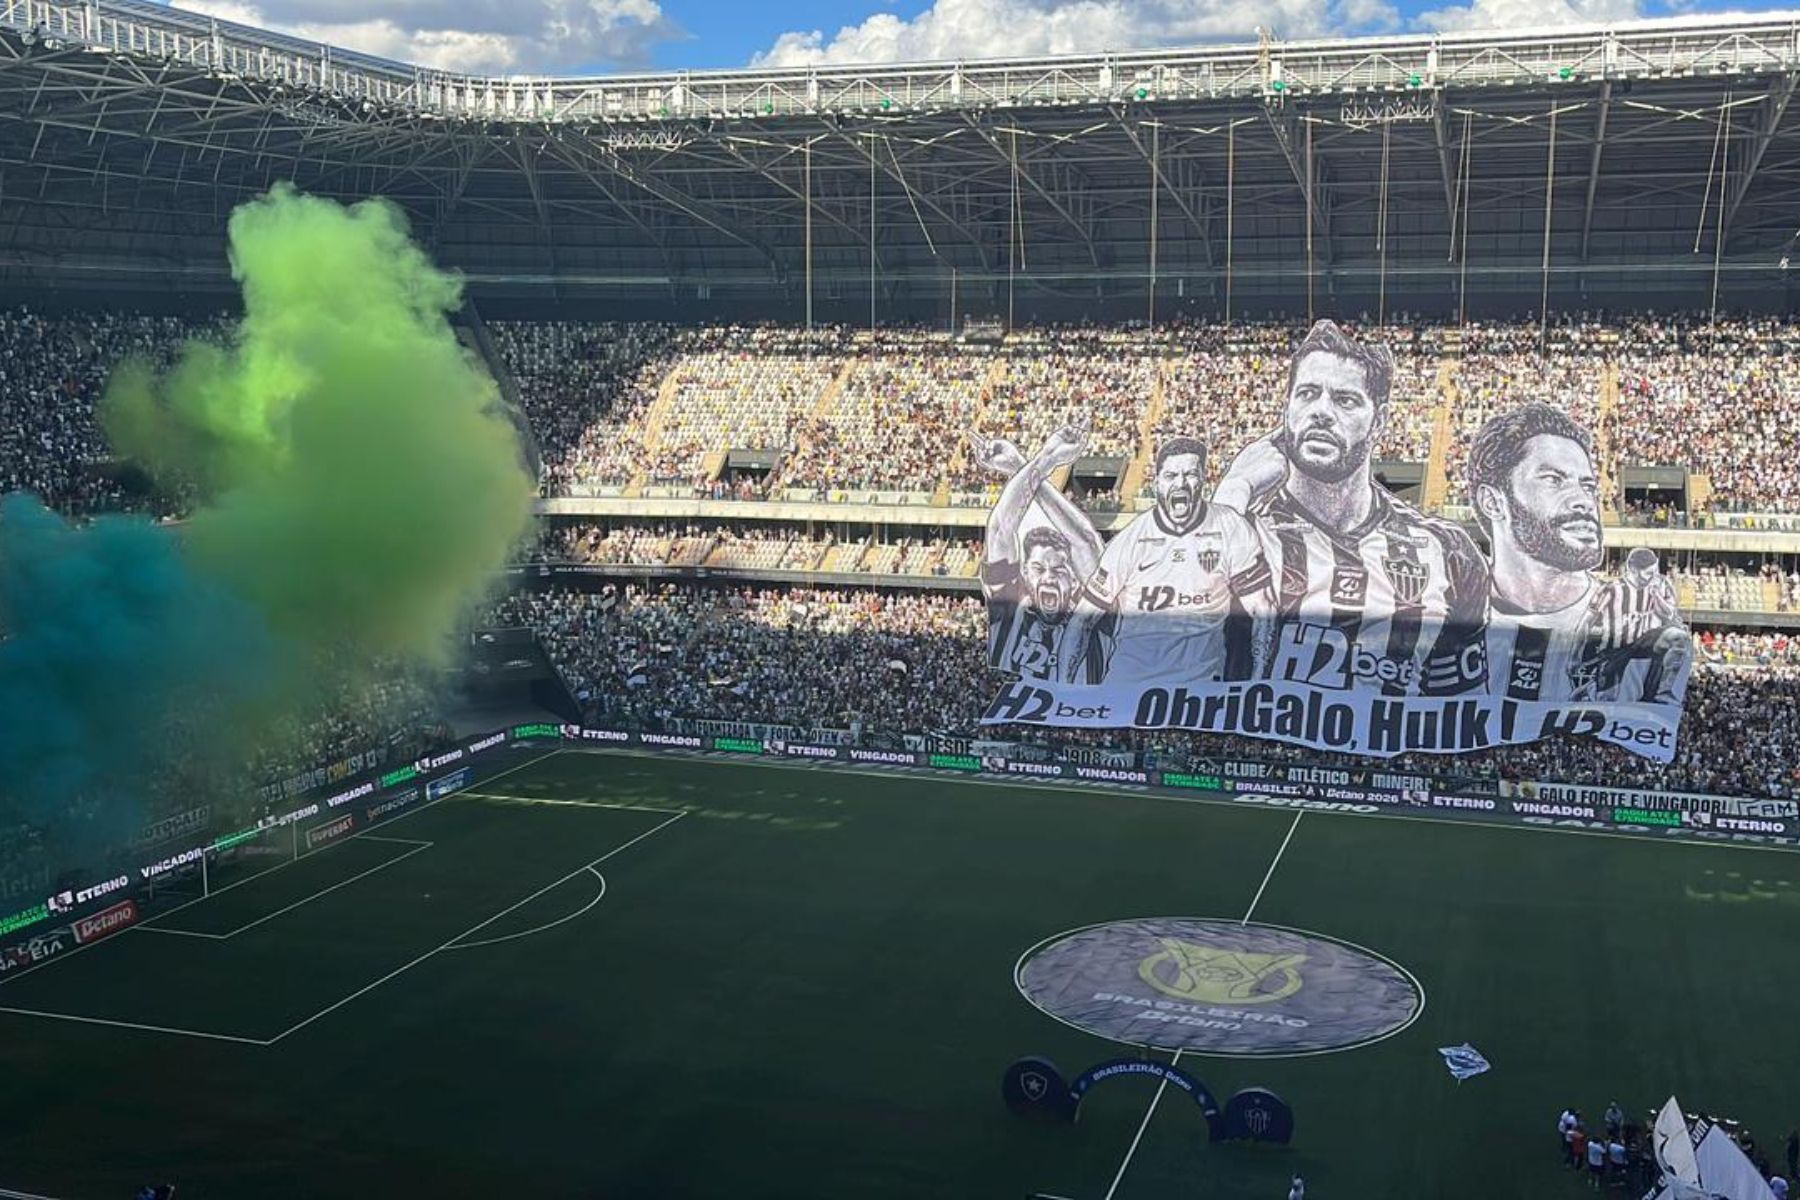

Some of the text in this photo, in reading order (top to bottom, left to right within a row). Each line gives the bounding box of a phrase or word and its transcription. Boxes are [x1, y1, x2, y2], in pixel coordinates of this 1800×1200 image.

[582, 729, 629, 741] ETERNO
[640, 733, 701, 747] VINGADOR
[787, 745, 837, 758] ETERNO
[850, 749, 915, 764] VINGADOR
[1008, 762, 1062, 775] ETERNO
[1076, 767, 1147, 783] VINGADOR
[1287, 766, 1349, 785] ATLÉTICO
[1433, 796, 1495, 810] ETERNO
[1512, 802, 1595, 818] VINGADOR
[1716, 818, 1785, 832] ETERNO
[76, 876, 129, 903] ETERNO
[81, 907, 132, 937] Betano
